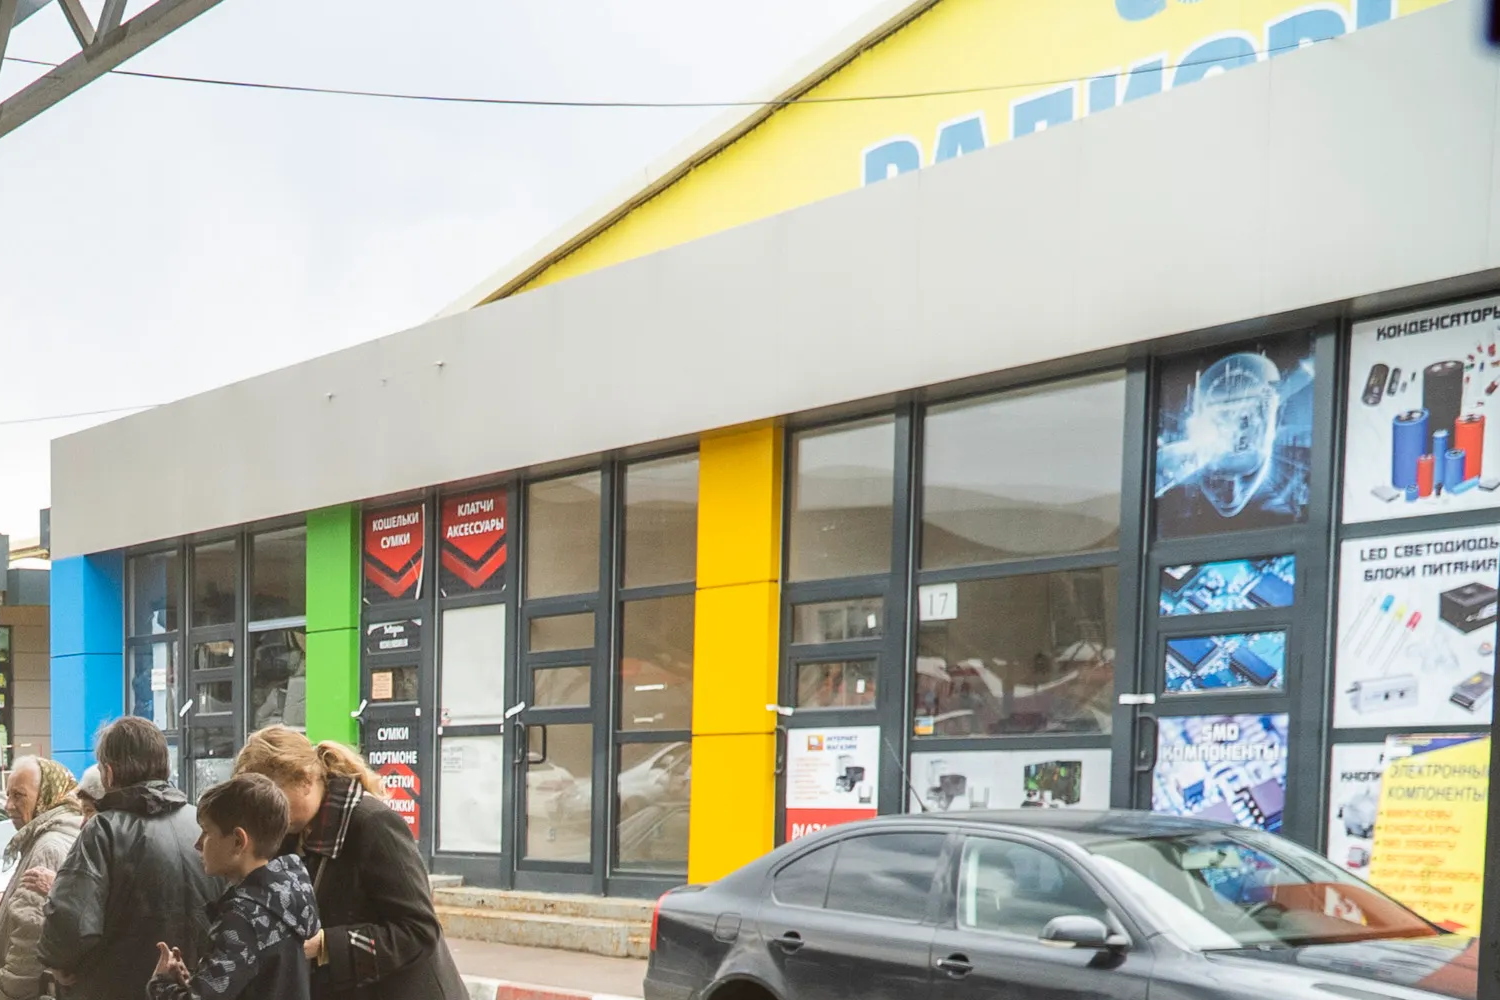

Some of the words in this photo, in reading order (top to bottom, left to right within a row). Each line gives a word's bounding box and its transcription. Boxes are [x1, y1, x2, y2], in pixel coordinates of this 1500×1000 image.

[457, 498, 494, 517] КЛАТЧИ
[372, 511, 420, 532] КОШЕЛЬКИ
[446, 516, 505, 539] АКСЕССУАРЫ
[380, 532, 411, 549] СУМКИ
[1363, 566, 1416, 582] БЛОКИ
[1422, 558, 1498, 577] ПИТАНИЯ
[929, 592, 949, 617] 17
[377, 727, 409, 741] СУМКИ
[369, 751, 417, 765] ПОРТМОНЕ
[1161, 741, 1280, 762] КОМПОНЕНТЫ
[382, 775, 415, 789] РСЕТКИ
